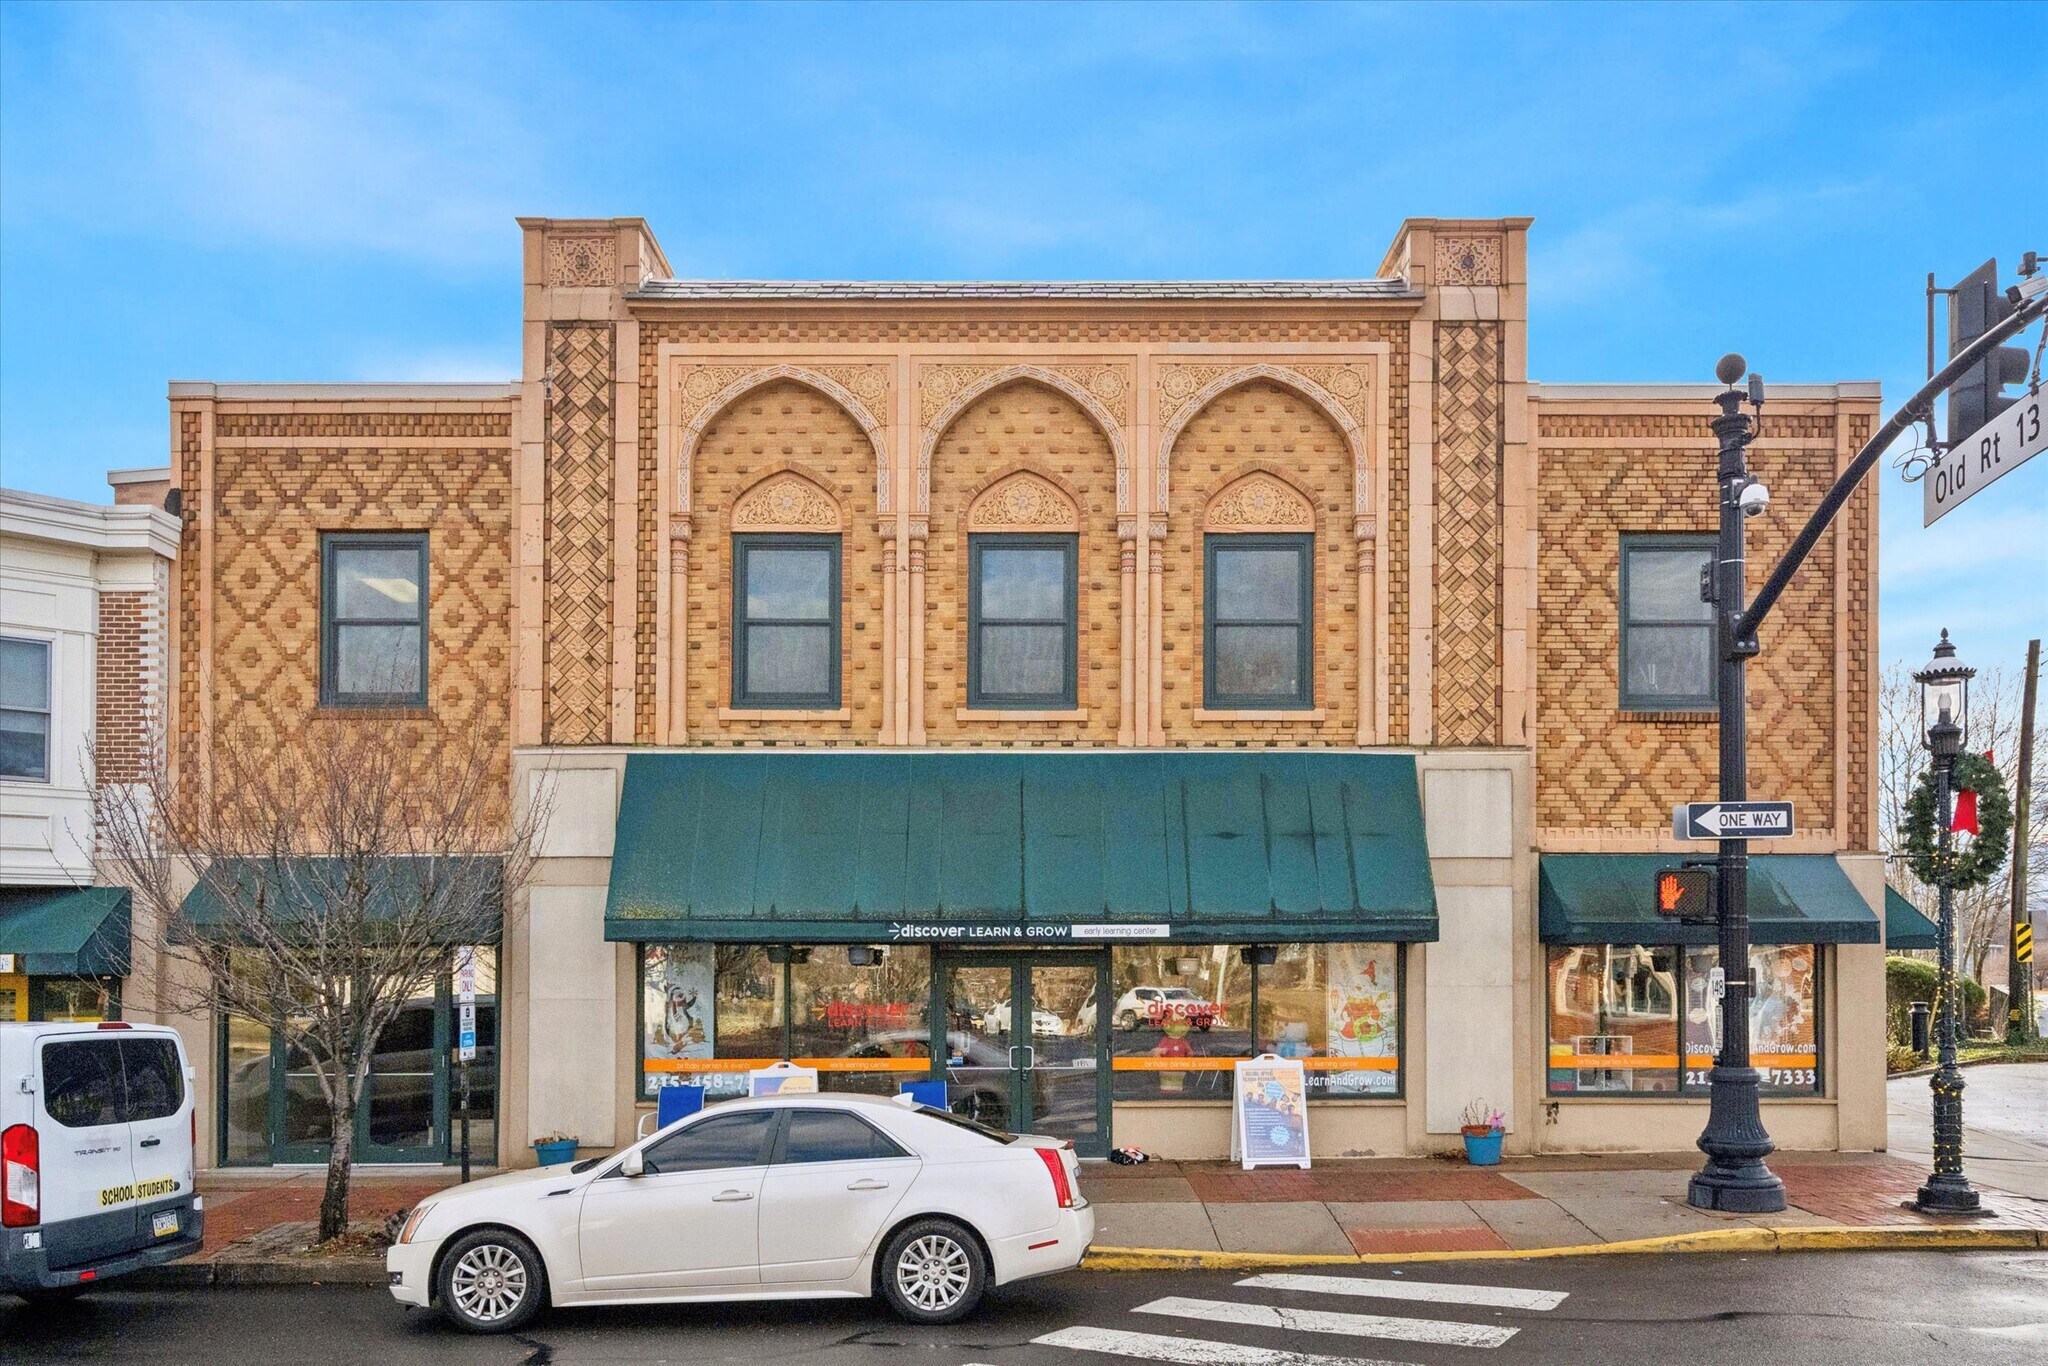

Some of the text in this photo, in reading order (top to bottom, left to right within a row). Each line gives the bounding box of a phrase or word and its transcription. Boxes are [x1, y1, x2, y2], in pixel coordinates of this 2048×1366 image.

[1935, 403, 2040, 504] Old Rt 13
[1719, 812, 1781, 827] ONE WAY
[901, 924, 1068, 937] discover LEARN & GROW
[1084, 926, 1157, 936] early learning center
[462, 980, 473, 992] ONLY
[1147, 1000, 1229, 1017] discover
[676, 1062, 700, 1071] birthday
[702, 1062, 722, 1071] parties
[845, 1061, 868, 1070] learning
[871, 1061, 889, 1069] center
[1315, 1061, 1338, 1070] learning
[74, 1146, 111, 1157] TRANSIT
[101, 1179, 174, 1206] SCHOOL STUDENTS
